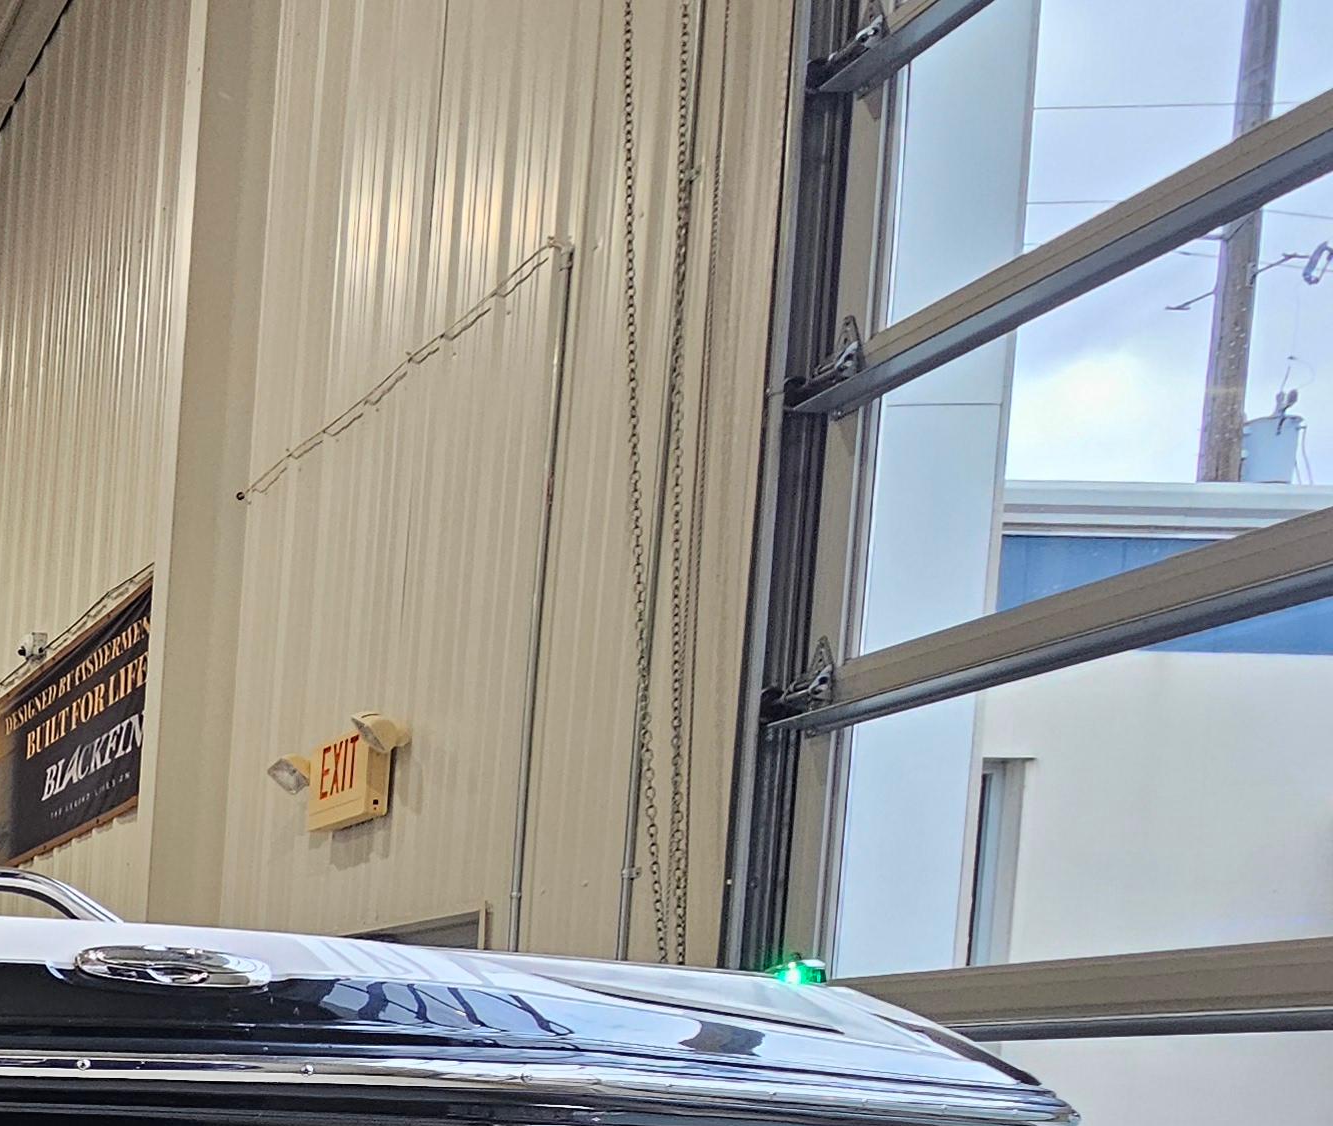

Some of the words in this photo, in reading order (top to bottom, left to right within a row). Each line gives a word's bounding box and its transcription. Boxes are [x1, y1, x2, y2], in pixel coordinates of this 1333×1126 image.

[4, 684, 57, 736] DESIGNED
[26, 709, 69, 760] BUILT
[70, 683, 106, 731] FOR
[107, 652, 148, 706] LIFE
[41, 711, 144, 801] BLACKFIN
[319, 734, 360, 800] EXIT
